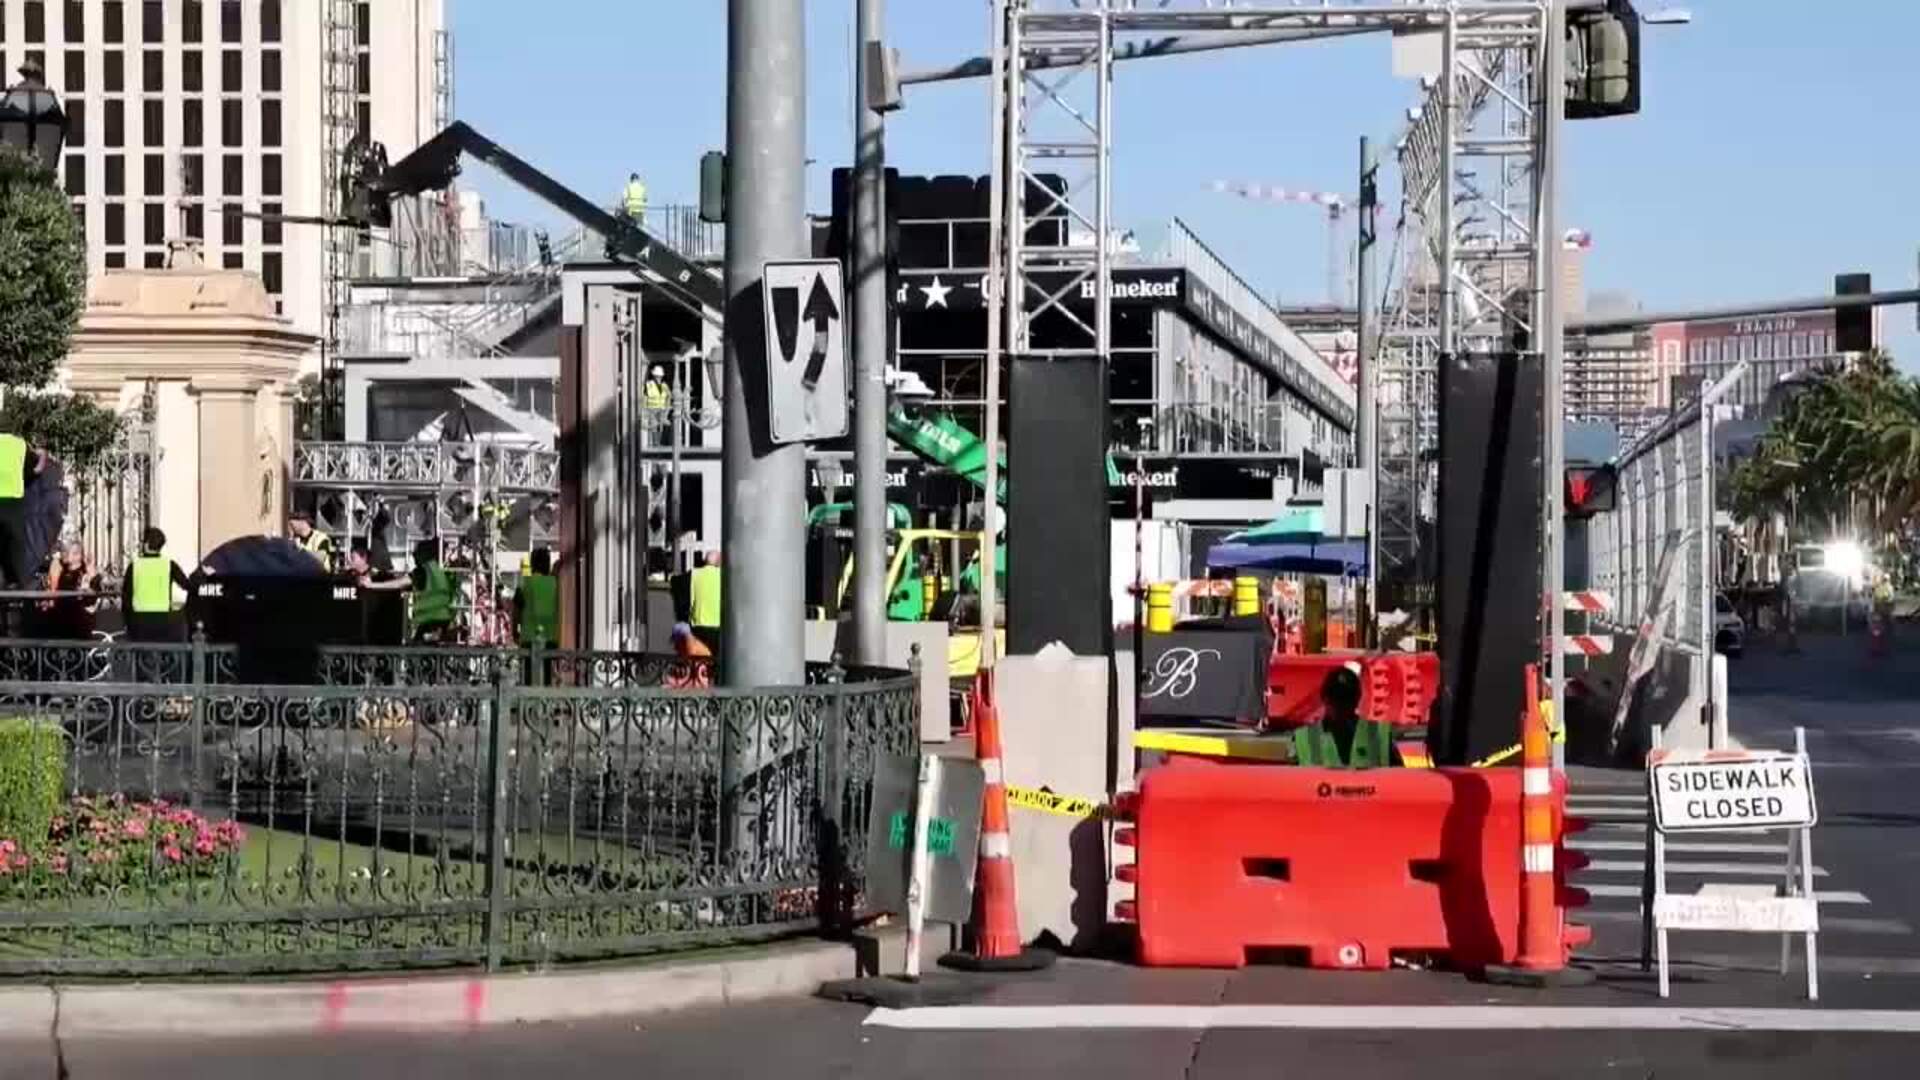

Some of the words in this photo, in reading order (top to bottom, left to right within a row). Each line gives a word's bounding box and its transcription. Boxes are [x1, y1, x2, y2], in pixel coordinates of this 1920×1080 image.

[1081, 276, 1179, 298] Hineken
[1668, 767, 1795, 792] SIDEWALK
[1687, 797, 1783, 819] CLOSED
